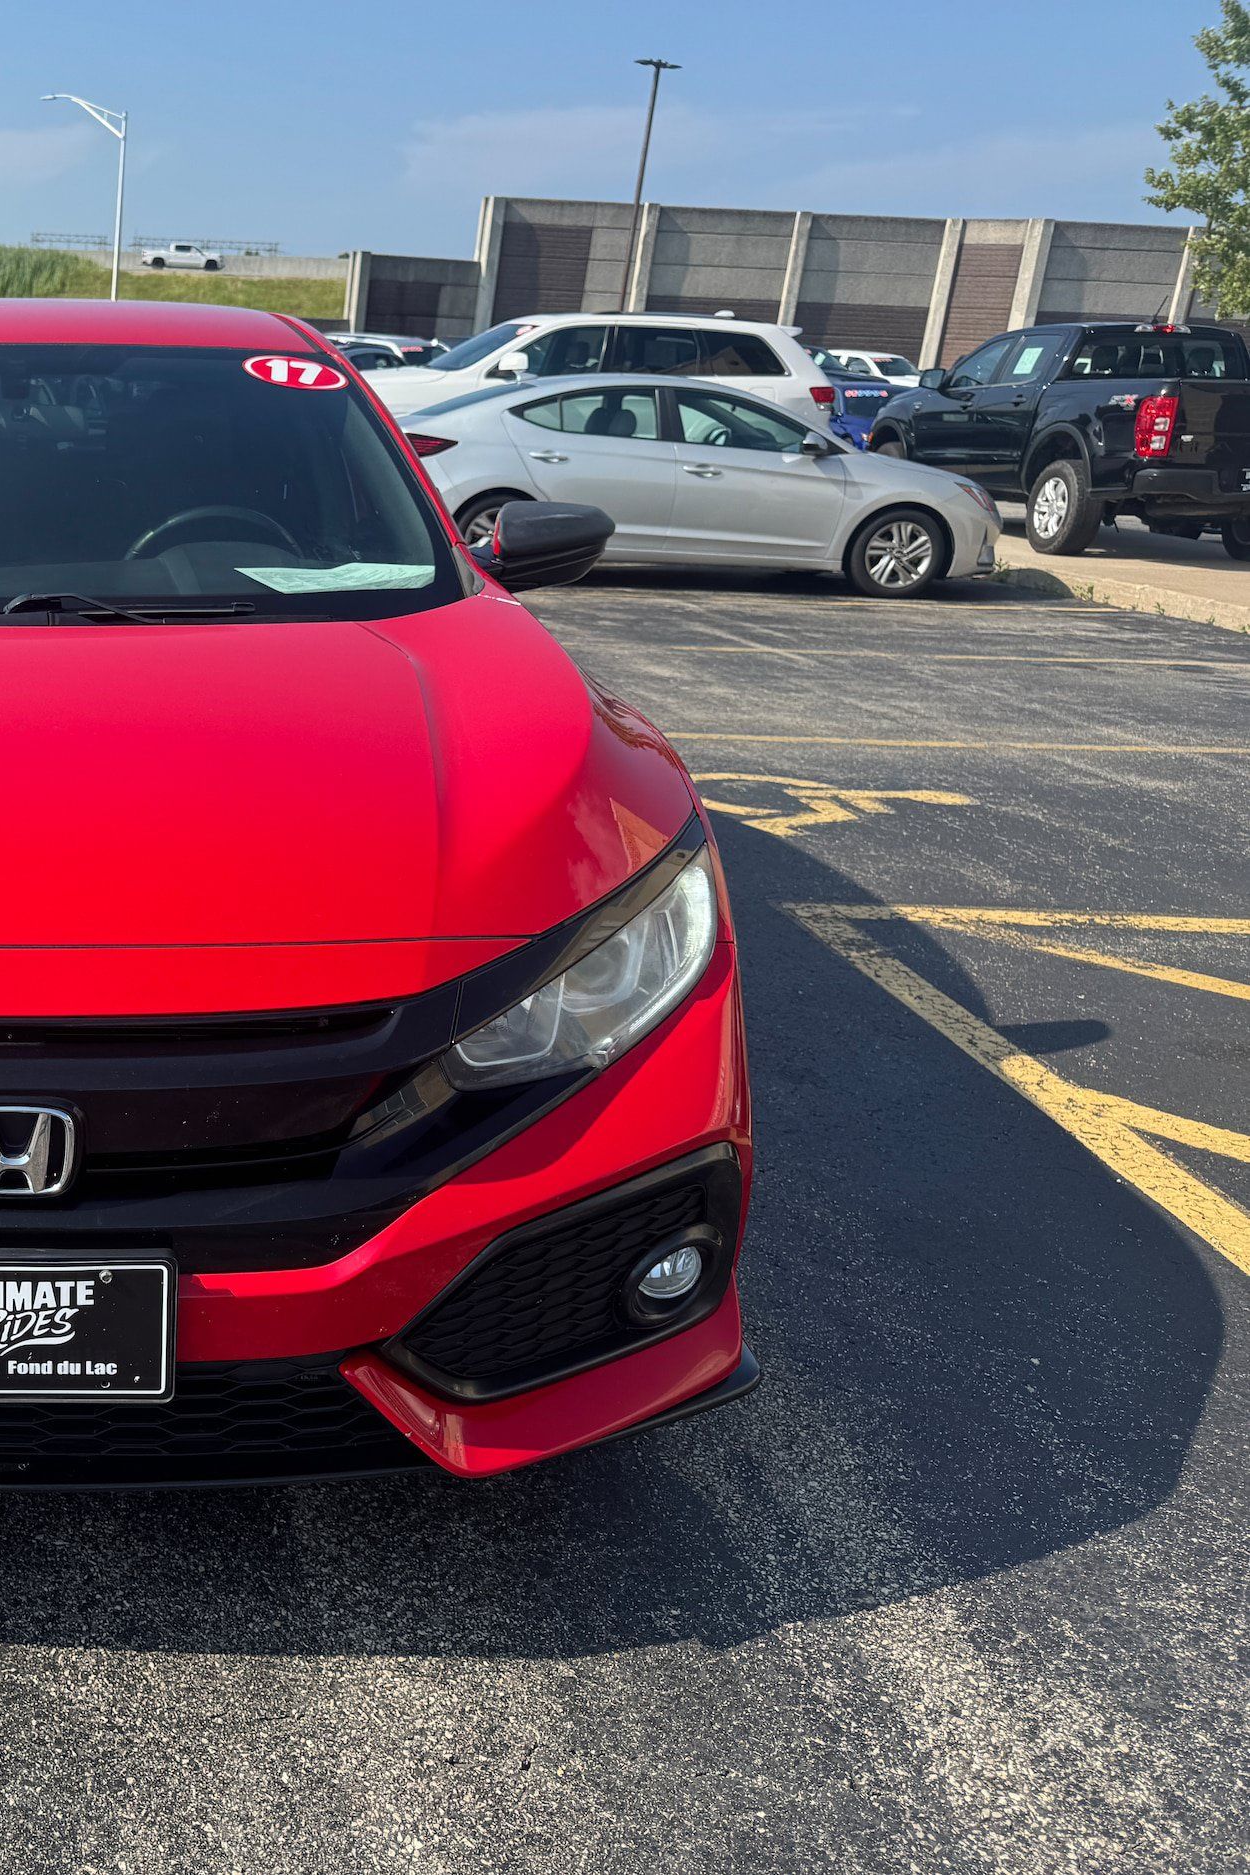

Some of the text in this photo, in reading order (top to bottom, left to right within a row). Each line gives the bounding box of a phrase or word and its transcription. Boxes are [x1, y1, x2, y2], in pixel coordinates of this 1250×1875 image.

[265, 359, 323, 385] 17
[7, 1360, 53, 1375] Fond
[56, 1360, 82, 1375] du
[85, 1360, 118, 1375] Lac
